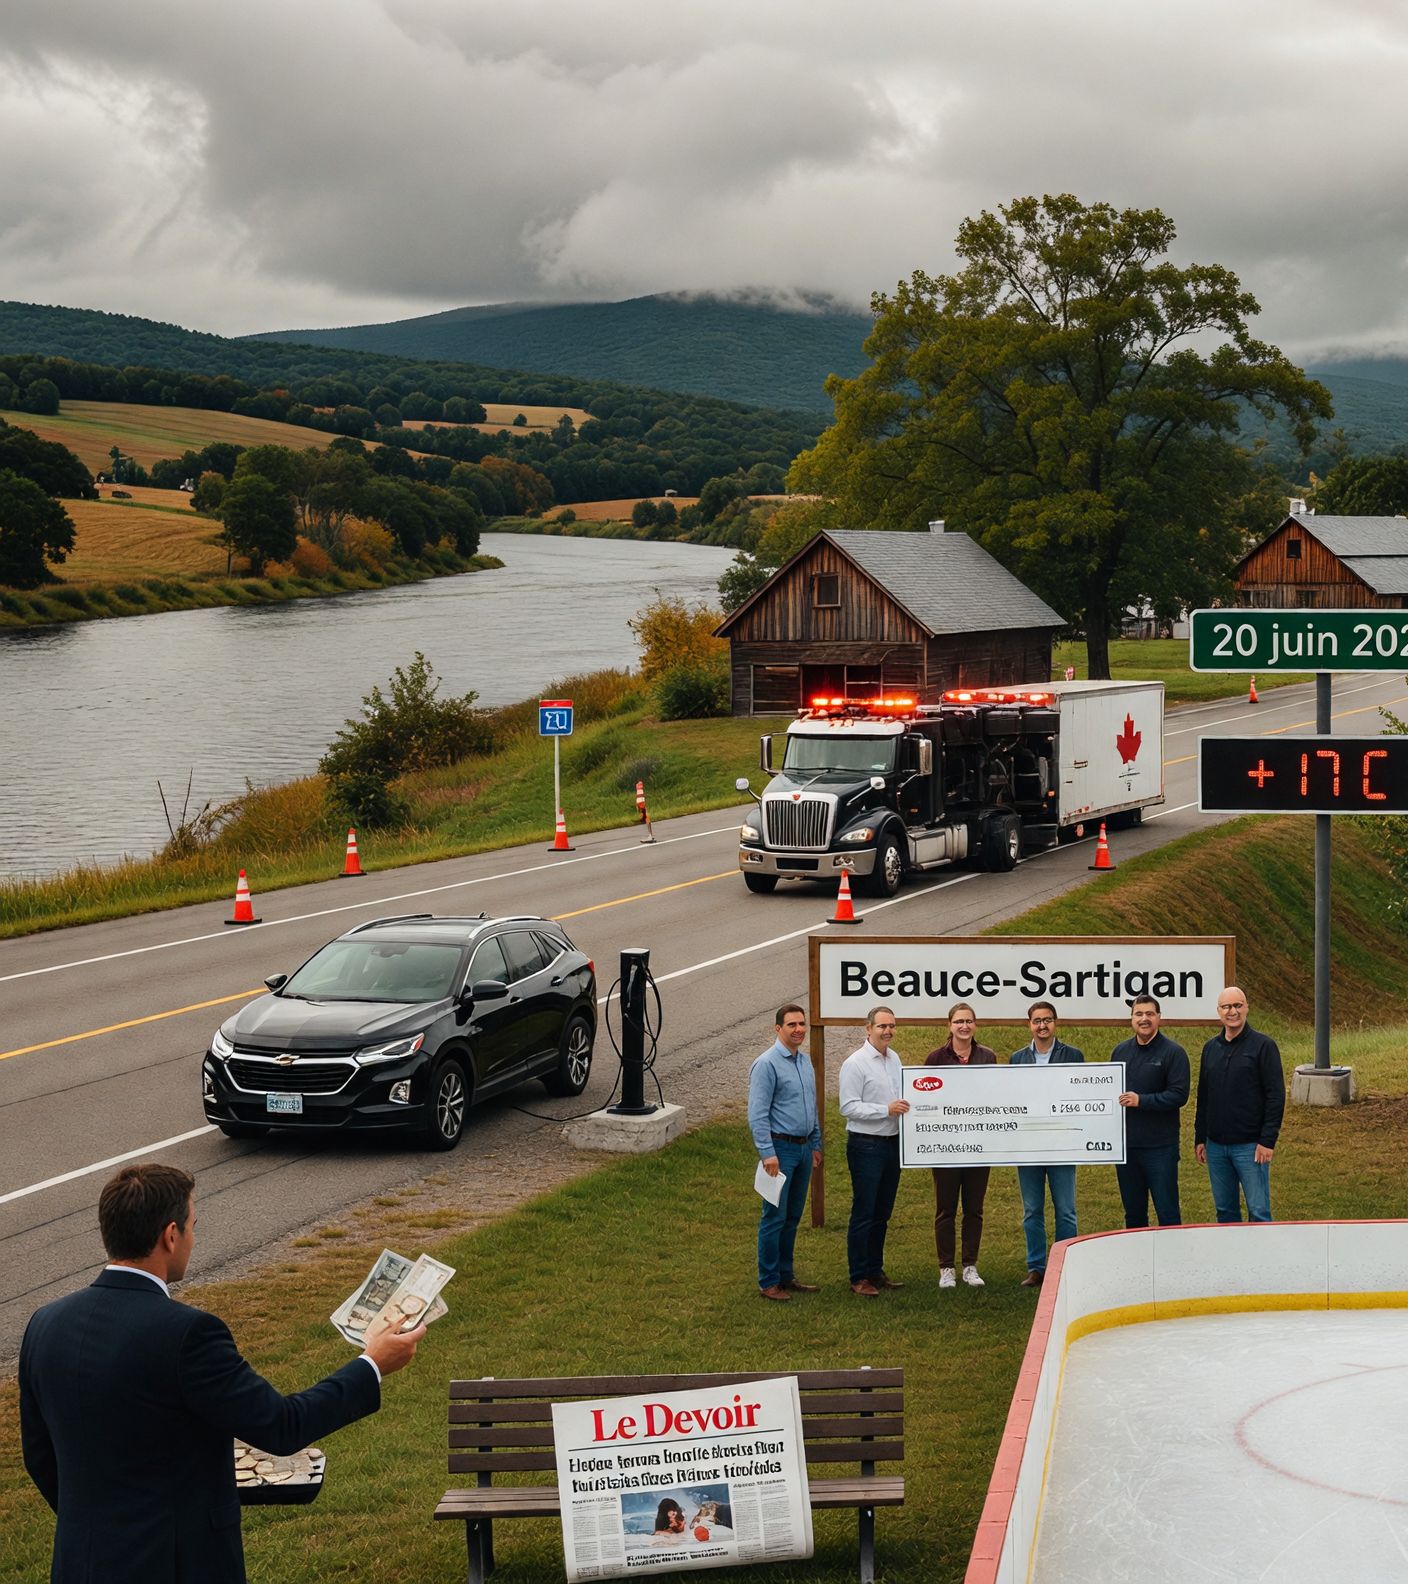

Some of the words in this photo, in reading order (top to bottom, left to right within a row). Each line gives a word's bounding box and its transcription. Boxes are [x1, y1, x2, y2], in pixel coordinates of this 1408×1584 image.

[1213, 624, 1257, 656] 20
[1268, 623, 1338, 665] juin
[1363, 750, 1388, 800] C
[841, 961, 1203, 1000] Beauce-Sartigan
[591, 1409, 637, 1442] Le
[643, 1394, 761, 1437] Devoir
